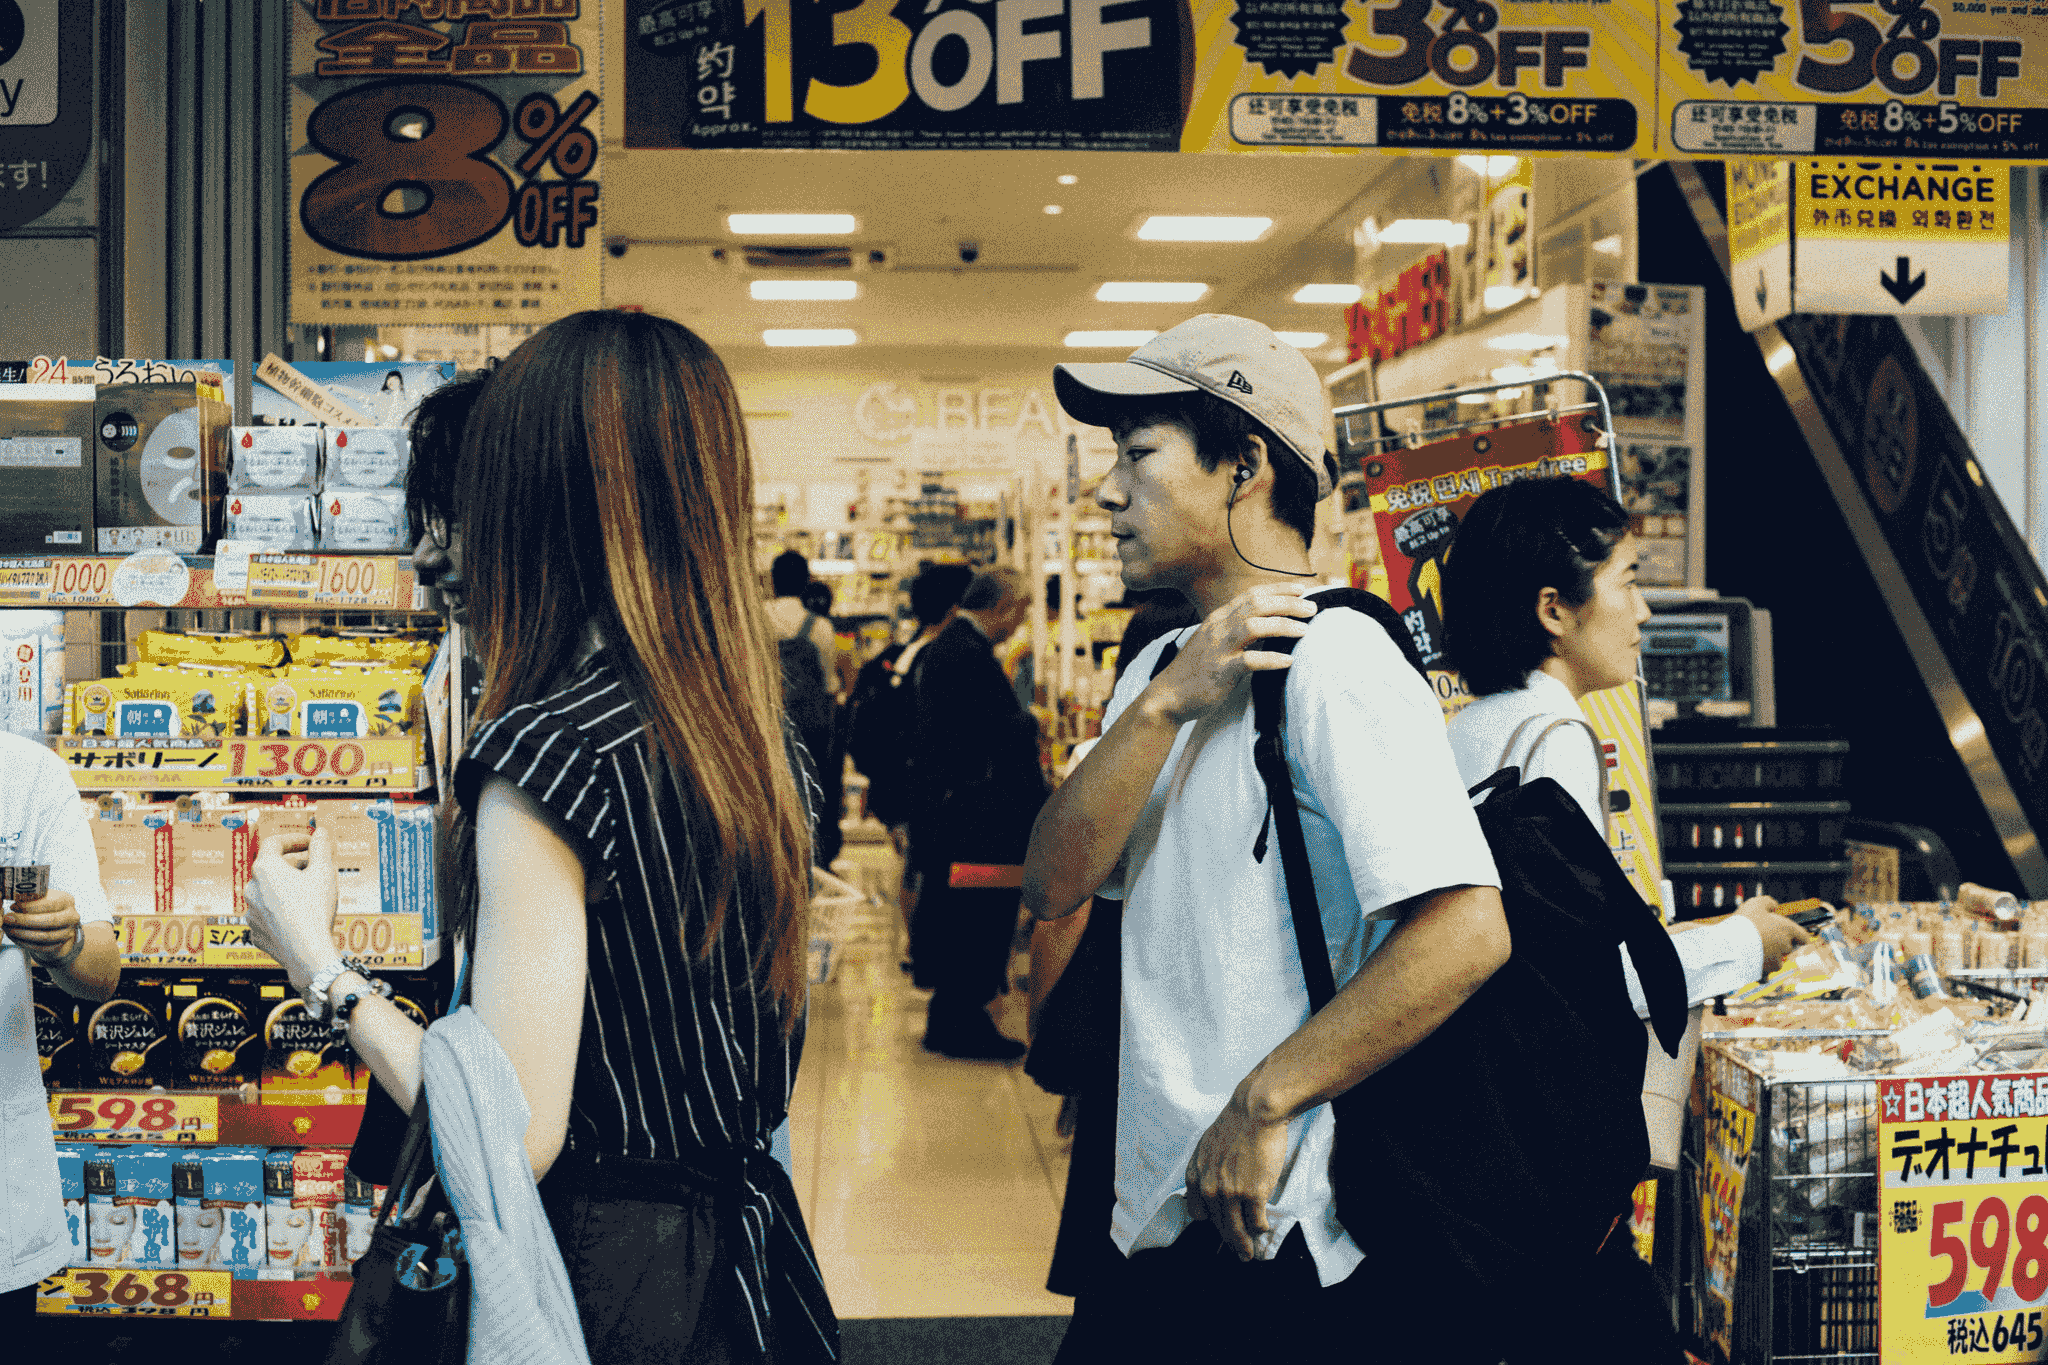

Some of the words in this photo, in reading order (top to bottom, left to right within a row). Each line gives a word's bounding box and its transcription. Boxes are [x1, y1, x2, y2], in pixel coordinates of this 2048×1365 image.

[316, 22, 582, 75] 全品
[911, 0, 1153, 112] OFF
[1430, 30, 1592, 90] OFF
[1875, 38, 2024, 97] OFF
[0, 160, 48, 190] す!
[1811, 174, 1995, 202] EXCHANGE
[513, 181, 600, 248] OFF
[34, 357, 68, 386] 24
[53, 562, 107, 595] 1000
[319, 560, 377, 595] 1600
[230, 742, 365, 777] 1300
[125, 918, 204, 955] 1200
[57, 1097, 177, 1131] 598
[1904, 1076, 2048, 1122] 日本超人気商品
[1892, 1123, 2048, 1183] デオナチュ
[1927, 1194, 2048, 1308] 598
[72, 1271, 190, 1307] 368
